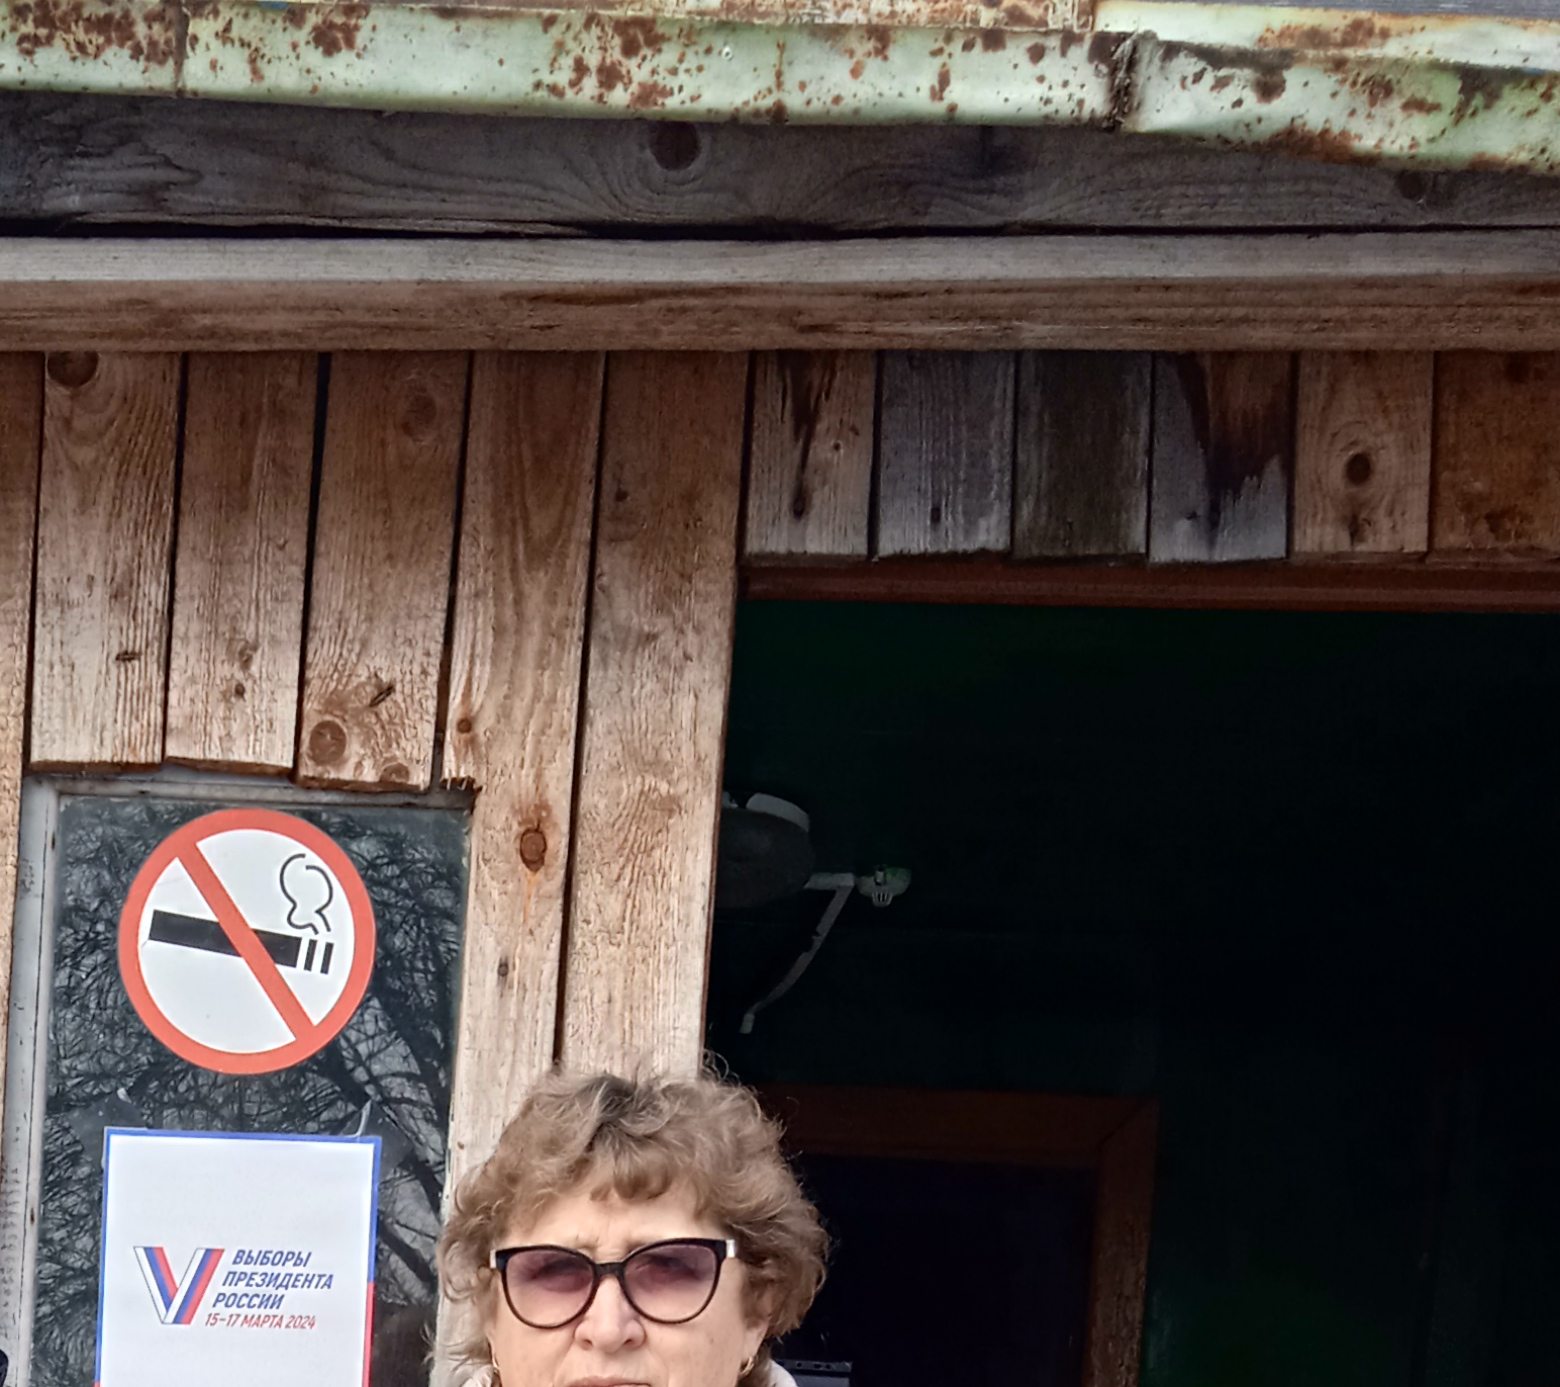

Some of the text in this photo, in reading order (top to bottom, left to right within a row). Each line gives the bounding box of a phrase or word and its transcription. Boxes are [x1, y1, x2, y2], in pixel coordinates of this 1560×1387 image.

[232, 1250, 312, 1267] ВЫБОРЫ
[222, 1271, 333, 1291] ПРЕЗИДЕНТА
[212, 1293, 284, 1309] РОССИИ
[241, 1314, 284, 1329] МАРТА
[285, 1315, 316, 1330] 2024
